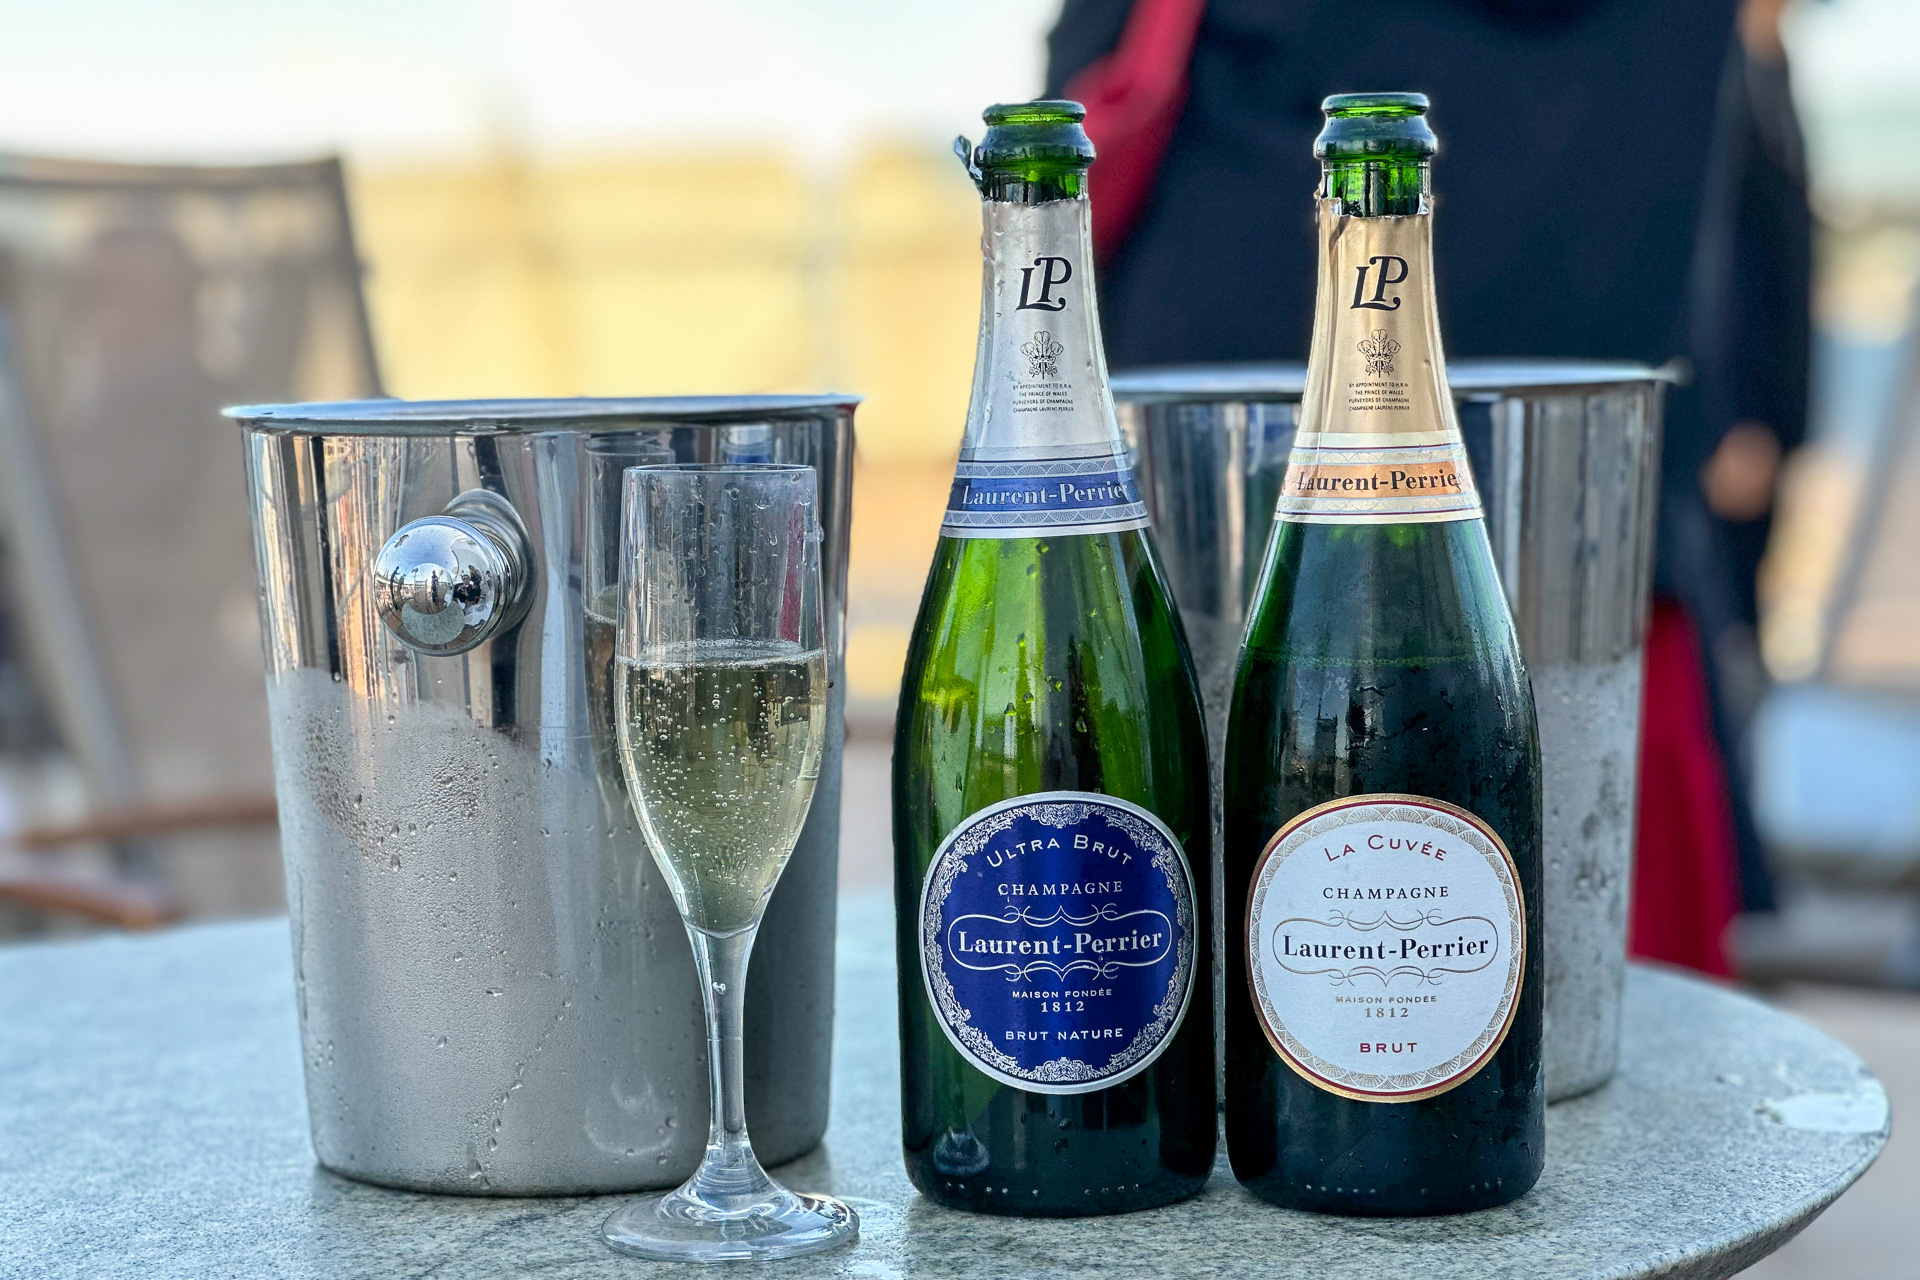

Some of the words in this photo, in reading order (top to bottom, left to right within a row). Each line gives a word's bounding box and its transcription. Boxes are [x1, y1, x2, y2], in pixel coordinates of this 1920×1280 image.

[1016, 257, 1072, 311] LP
[1350, 256, 1409, 311] LP
[962, 480, 1128, 505] Laurent-Perrier
[986, 836, 1061, 868] ULTRA
[1073, 834, 1132, 865] BRUT
[1324, 844, 1356, 862] LA
[1367, 834, 1447, 861] CUVÉE
[997, 881, 1124, 896] CHAMPAGNE
[1322, 886, 1450, 900] CHAMPAGNE
[958, 929, 1163, 955] Laurent-Perrier
[1282, 934, 1489, 960] Laurent-Perrier
[1012, 990, 1059, 999] MAISON
[1065, 988, 1112, 998] FONDÉE
[1335, 996, 1383, 1004] MAISON
[1389, 995, 1437, 1004] FONDÉE
[1040, 1001, 1085, 1013] 1812
[1365, 1007, 1410, 1018] 1812
[1005, 1030, 1049, 1041] BRUT
[1057, 1028, 1124, 1041] NATURE
[1359, 1042, 1418, 1053] BRUT
